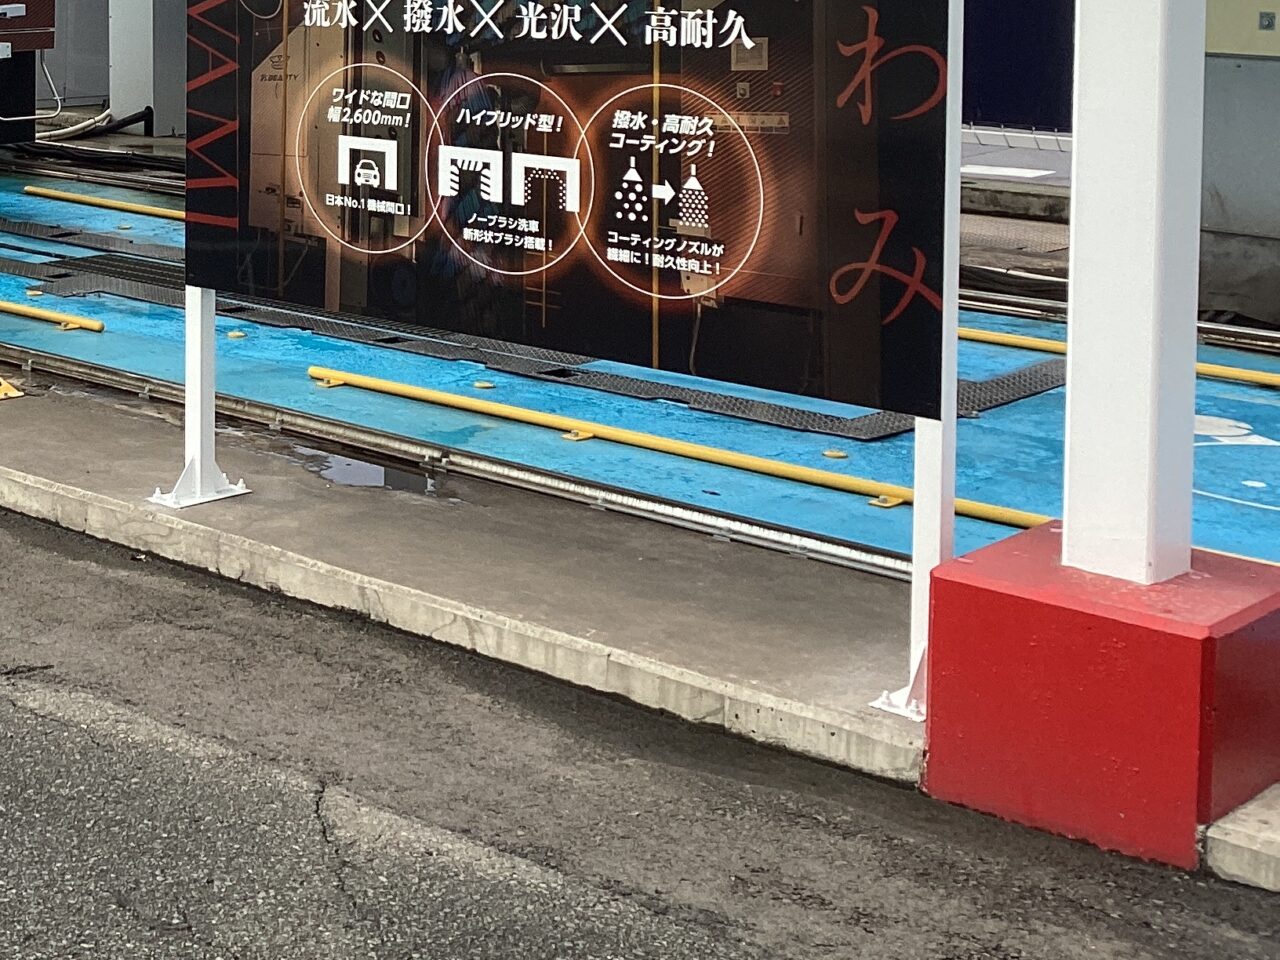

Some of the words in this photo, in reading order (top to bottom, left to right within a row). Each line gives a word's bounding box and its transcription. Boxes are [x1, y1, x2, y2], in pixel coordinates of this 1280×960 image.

[331, 87, 412, 110] ワイドな間口
[467, 212, 540, 233] ノーブラシ洗車
[607, 230, 725, 258] コーティングノズルが
